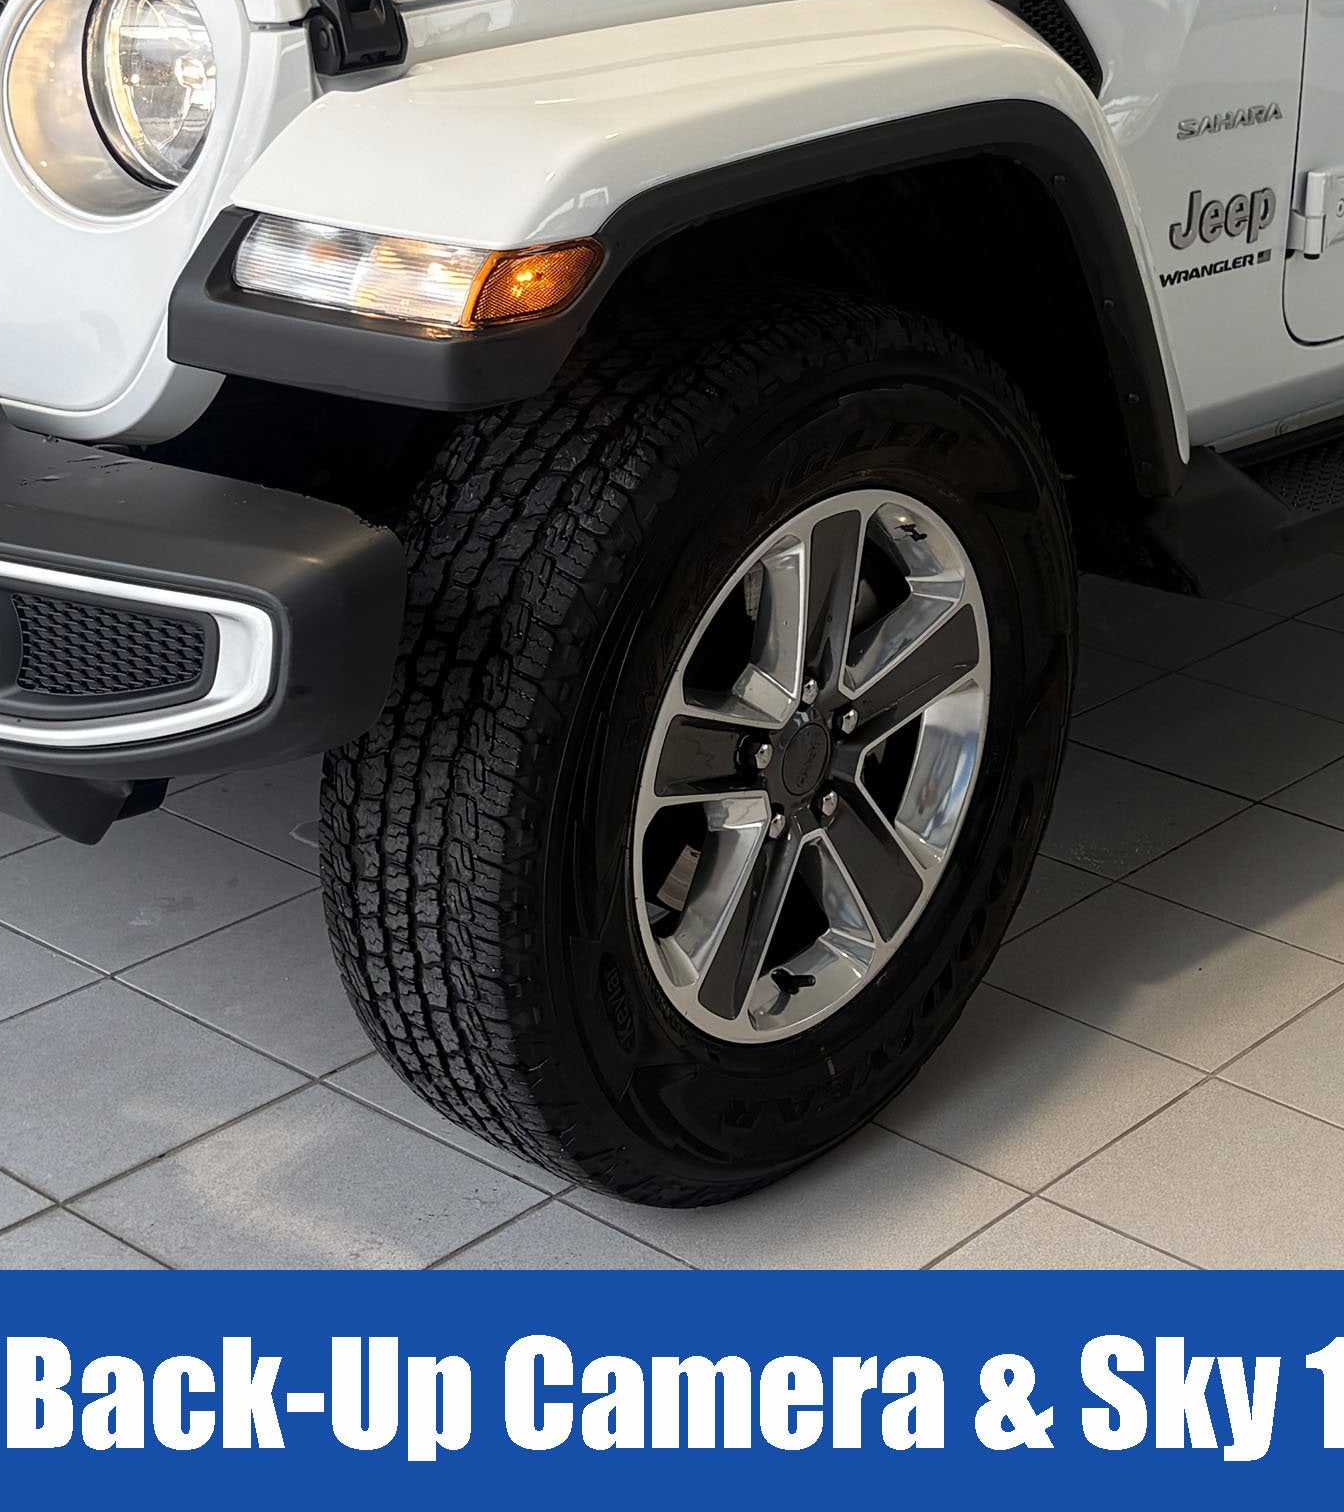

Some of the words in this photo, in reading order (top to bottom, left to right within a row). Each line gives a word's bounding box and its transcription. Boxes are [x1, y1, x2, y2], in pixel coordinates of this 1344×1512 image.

[1177, 102, 1283, 141] SAHARA
[1169, 187, 1277, 251] Jeep
[1159, 252, 1255, 288] WRANGLER
